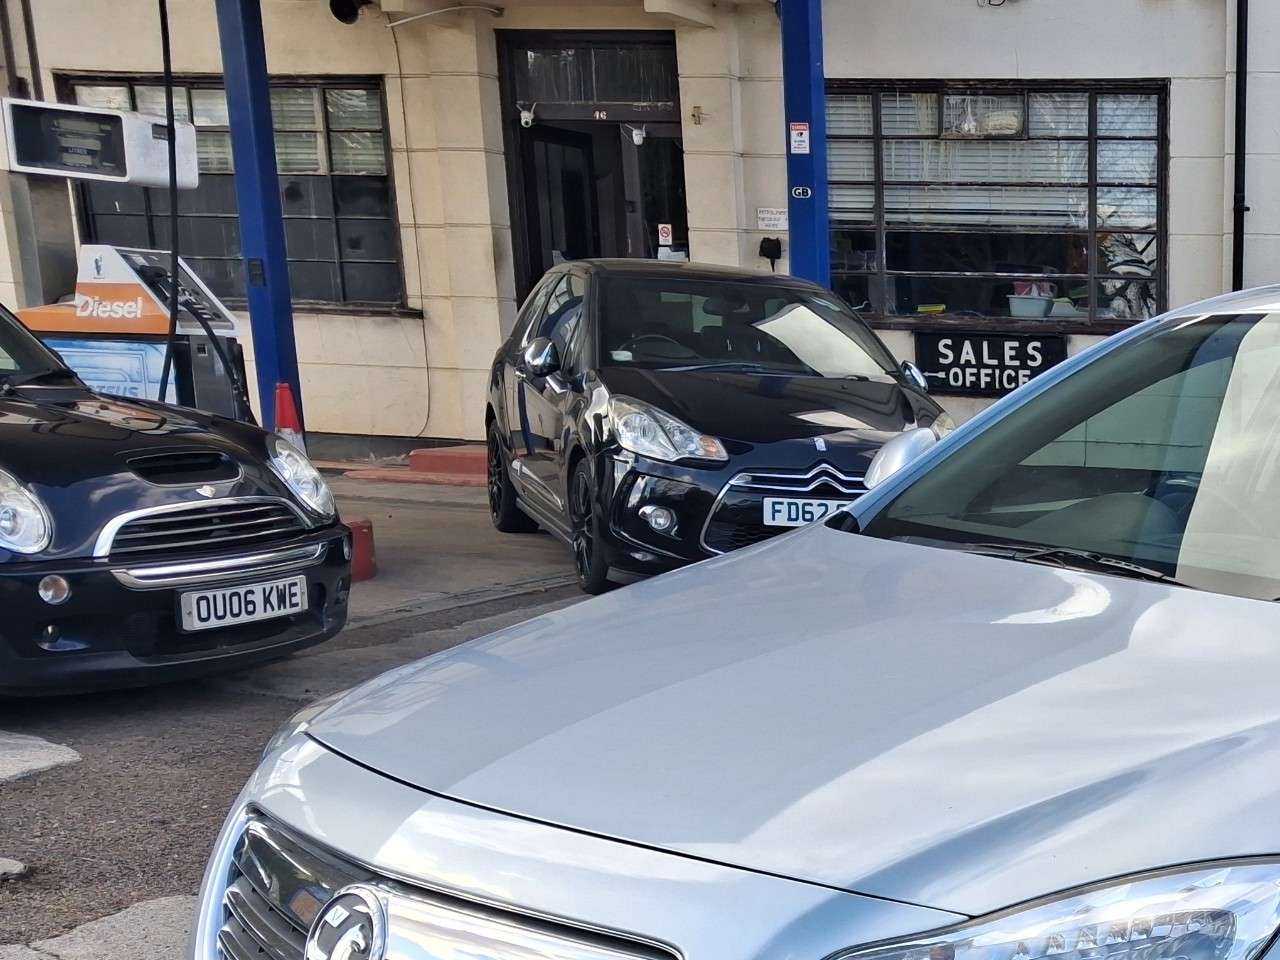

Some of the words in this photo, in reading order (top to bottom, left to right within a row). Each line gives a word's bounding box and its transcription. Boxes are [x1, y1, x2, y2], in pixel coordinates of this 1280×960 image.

[793, 187, 809, 197] GB
[75, 294, 144, 319] Diesel
[937, 338, 1043, 367] SALES
[948, 367, 1032, 389] OFFICE
[771, 501, 829, 522] FD62
[196, 589, 257, 622] OU06
[262, 582, 300, 613] KWE
